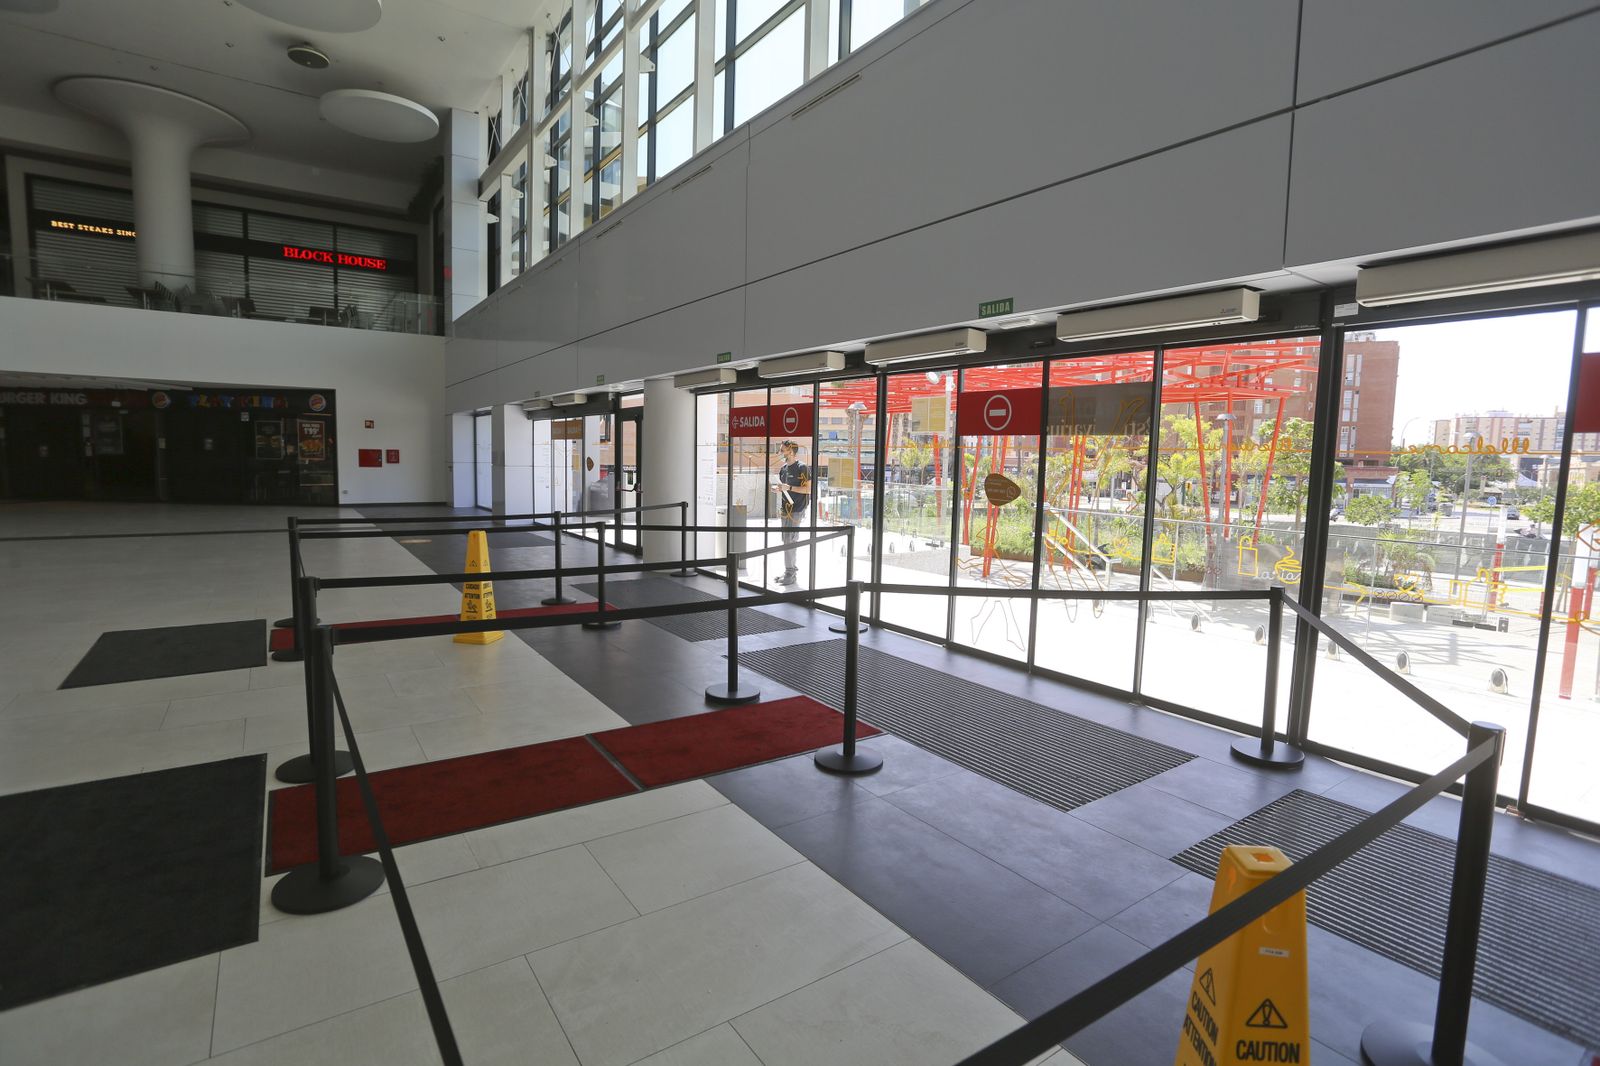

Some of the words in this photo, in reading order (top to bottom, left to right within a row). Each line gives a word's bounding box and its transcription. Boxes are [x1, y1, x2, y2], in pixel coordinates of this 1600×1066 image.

[50, 219, 75, 229] BEST
[77, 223, 114, 235] STEAKS
[283, 245, 334, 263] BLOCK
[337, 253, 387, 270] HOUSE
[981, 301, 1010, 316] SALIDA
[49, 391, 88, 405] KING
[739, 415, 766, 428] SALIDA
[1191, 991, 1219, 1047] CAUTION
[1235, 1039, 1300, 1064] CAUTION
